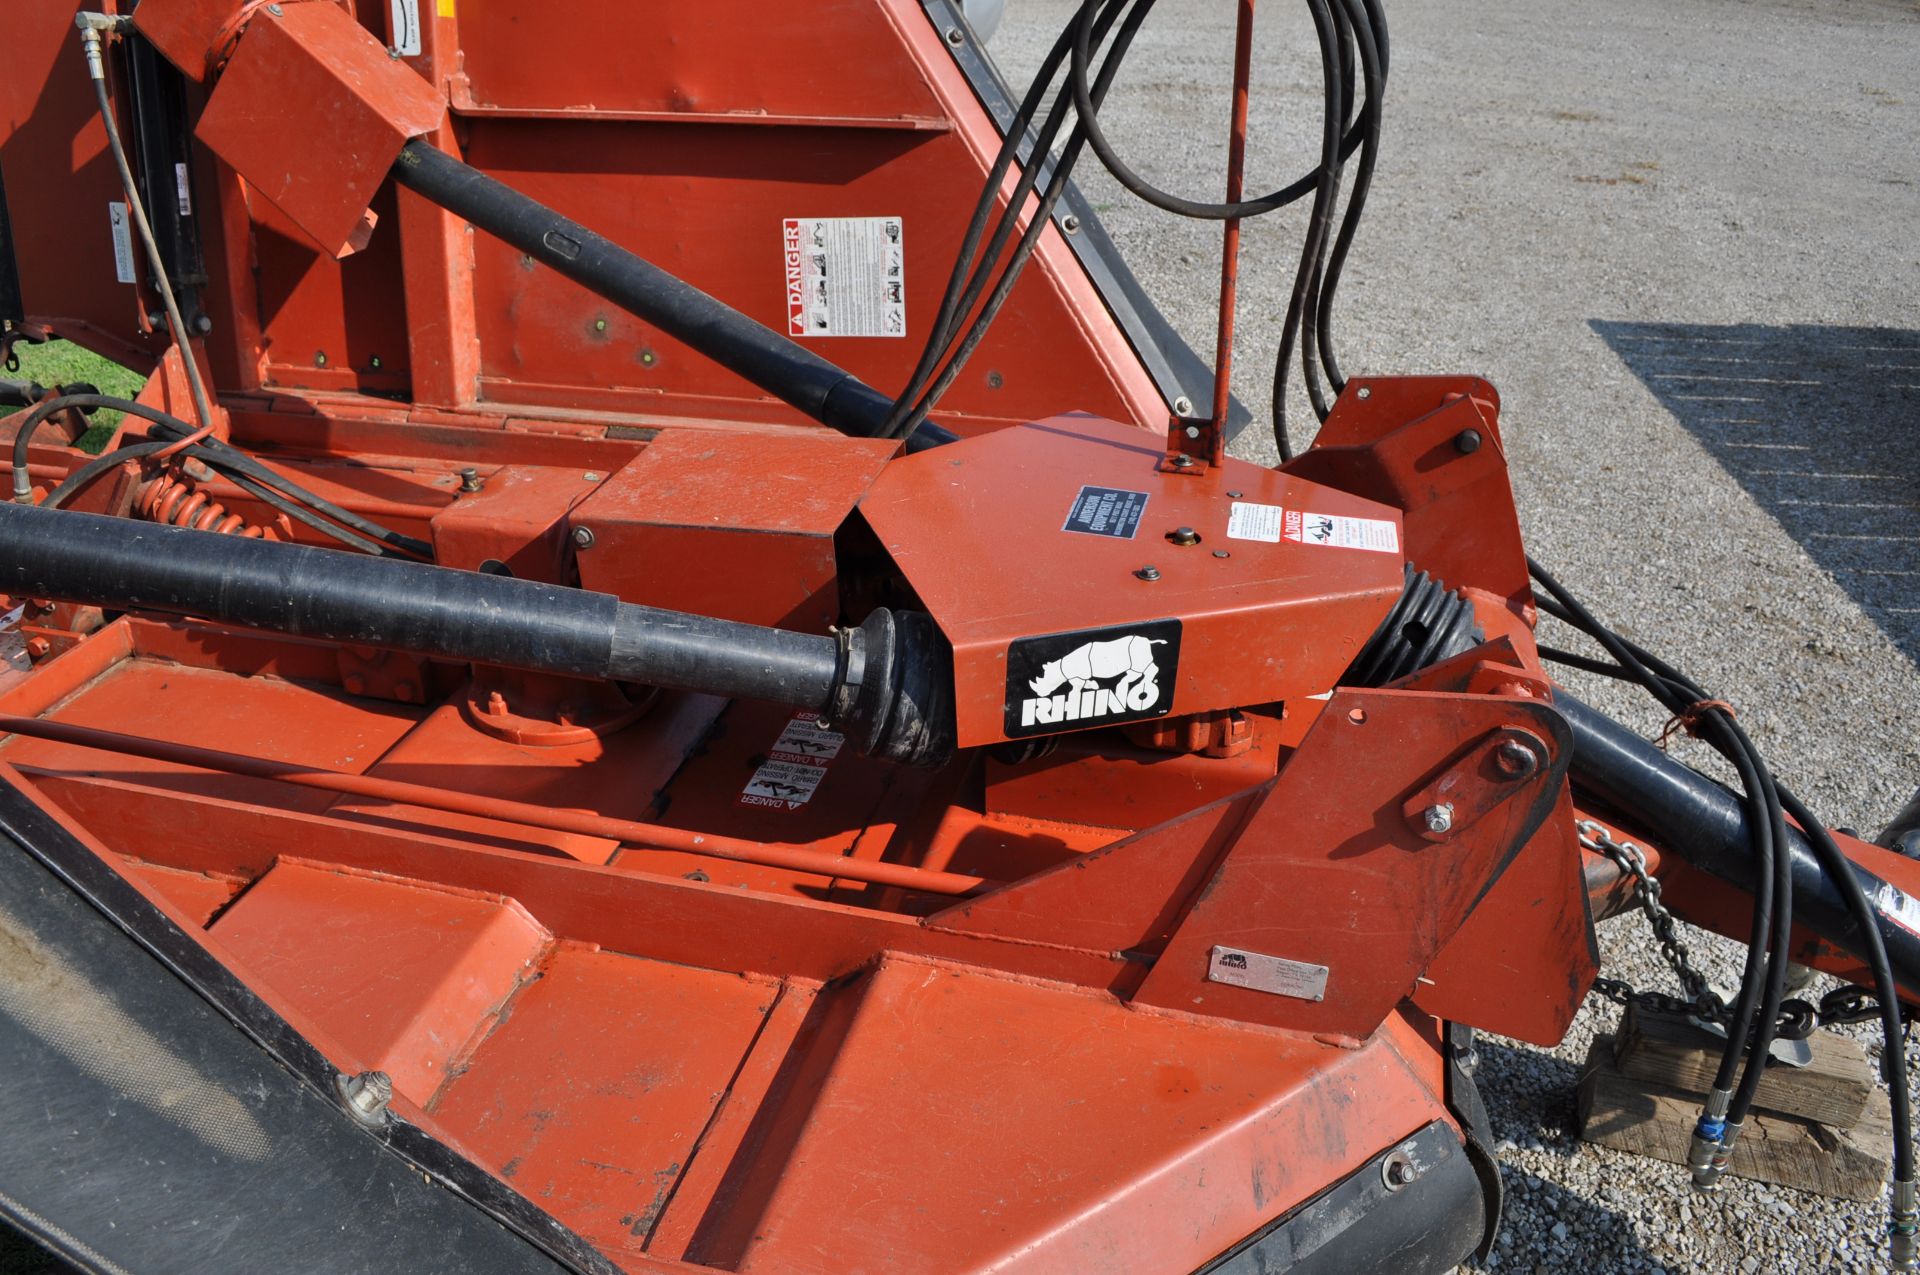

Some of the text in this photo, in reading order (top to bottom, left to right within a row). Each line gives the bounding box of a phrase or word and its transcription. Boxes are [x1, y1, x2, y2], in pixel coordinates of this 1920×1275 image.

[786, 227, 802, 305] DANGER
[1078, 495, 1101, 523] ANDERSON
[1090, 500, 1114, 531] EQUIPMENT
[1285, 511, 1301, 537] DANGER
[1021, 683, 1159, 727] RHINO
[771, 753, 811, 763] DANGER
[741, 795, 784, 808] DANGER
